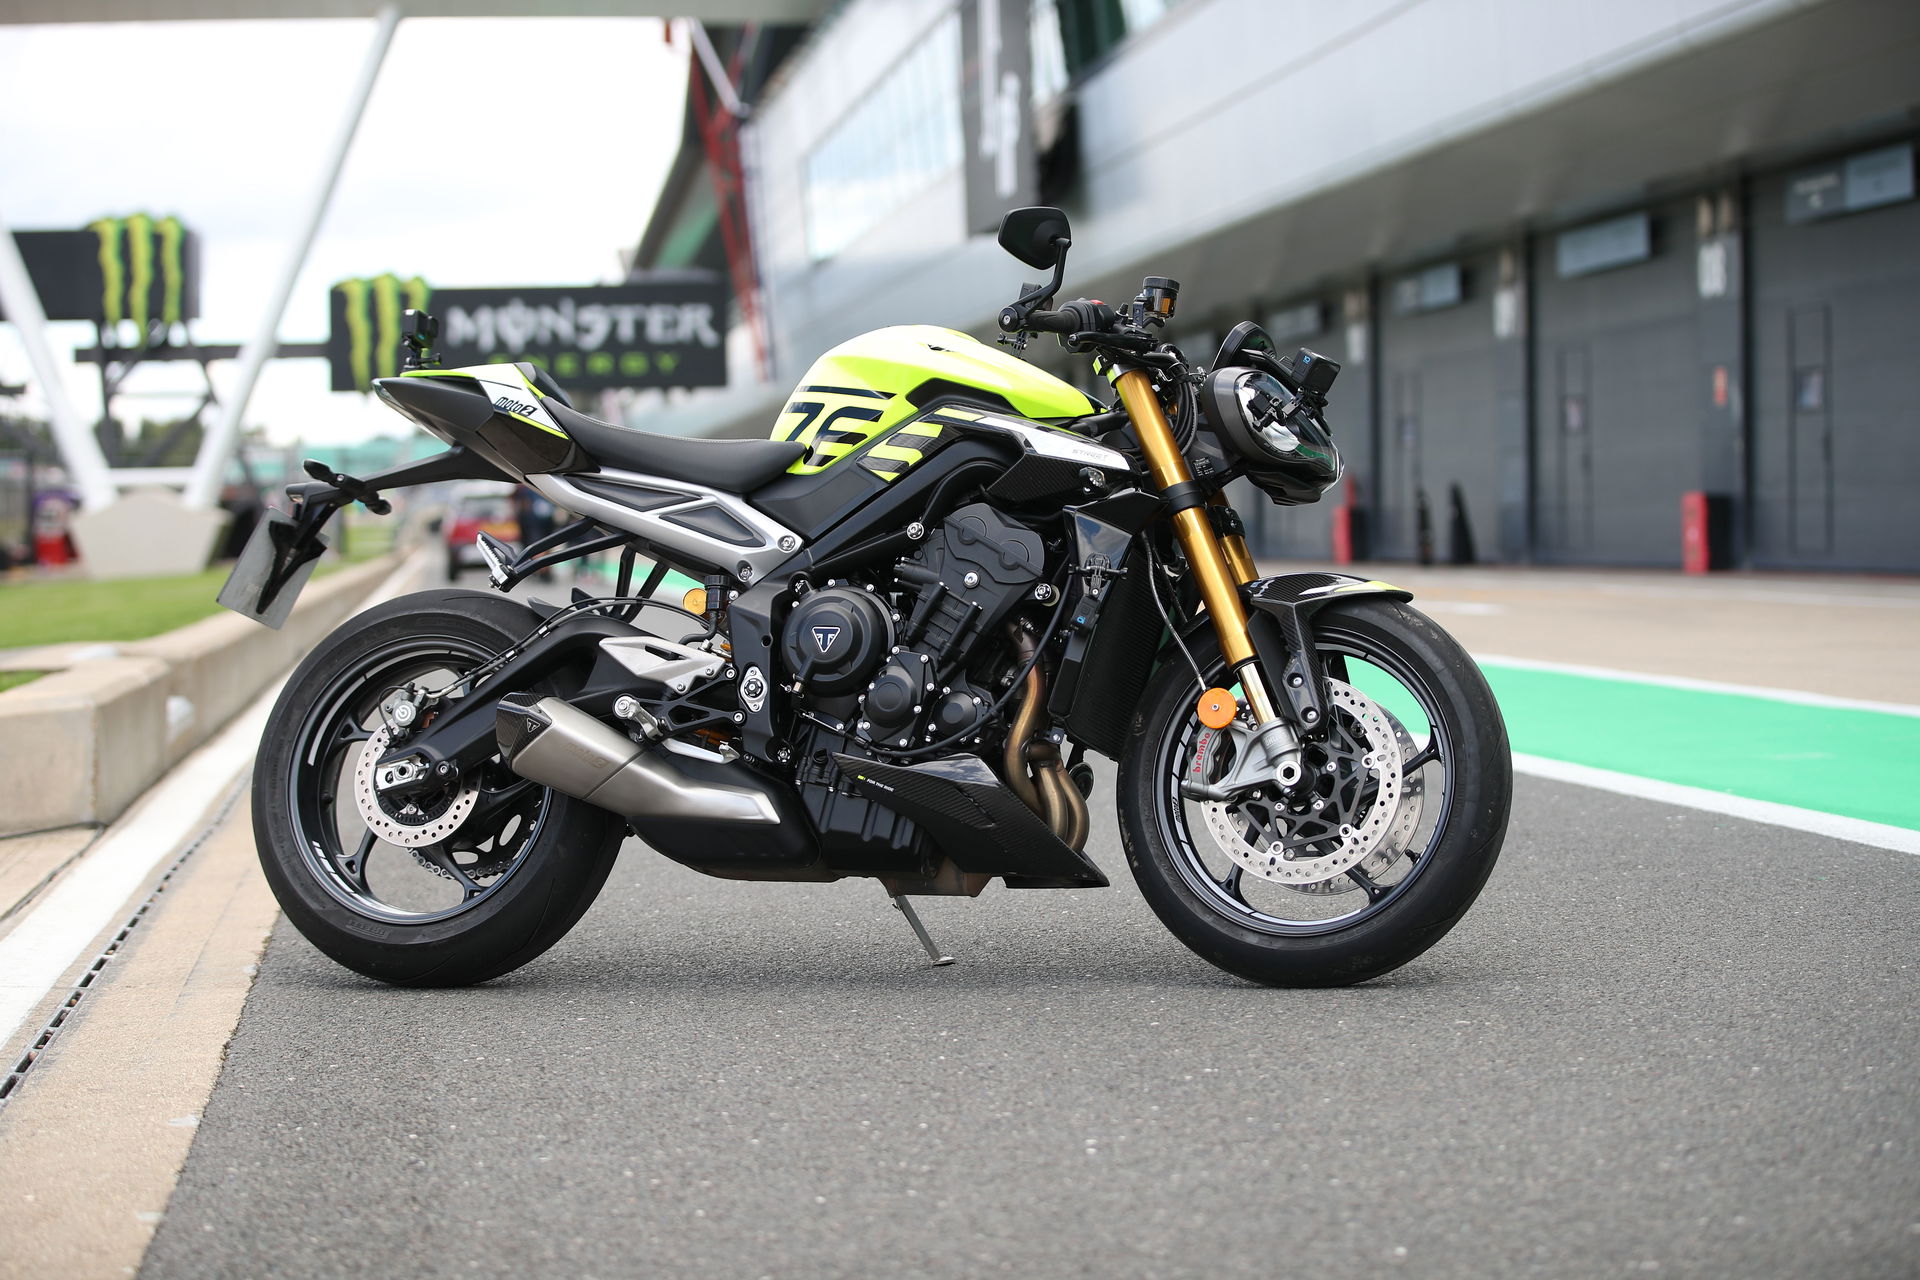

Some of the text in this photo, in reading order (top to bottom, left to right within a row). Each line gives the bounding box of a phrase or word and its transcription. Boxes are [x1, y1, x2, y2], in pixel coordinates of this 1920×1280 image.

[446, 296, 719, 351] MONSTER
[495, 396, 538, 417] moto2
[1192, 732, 1211, 773] brembo
